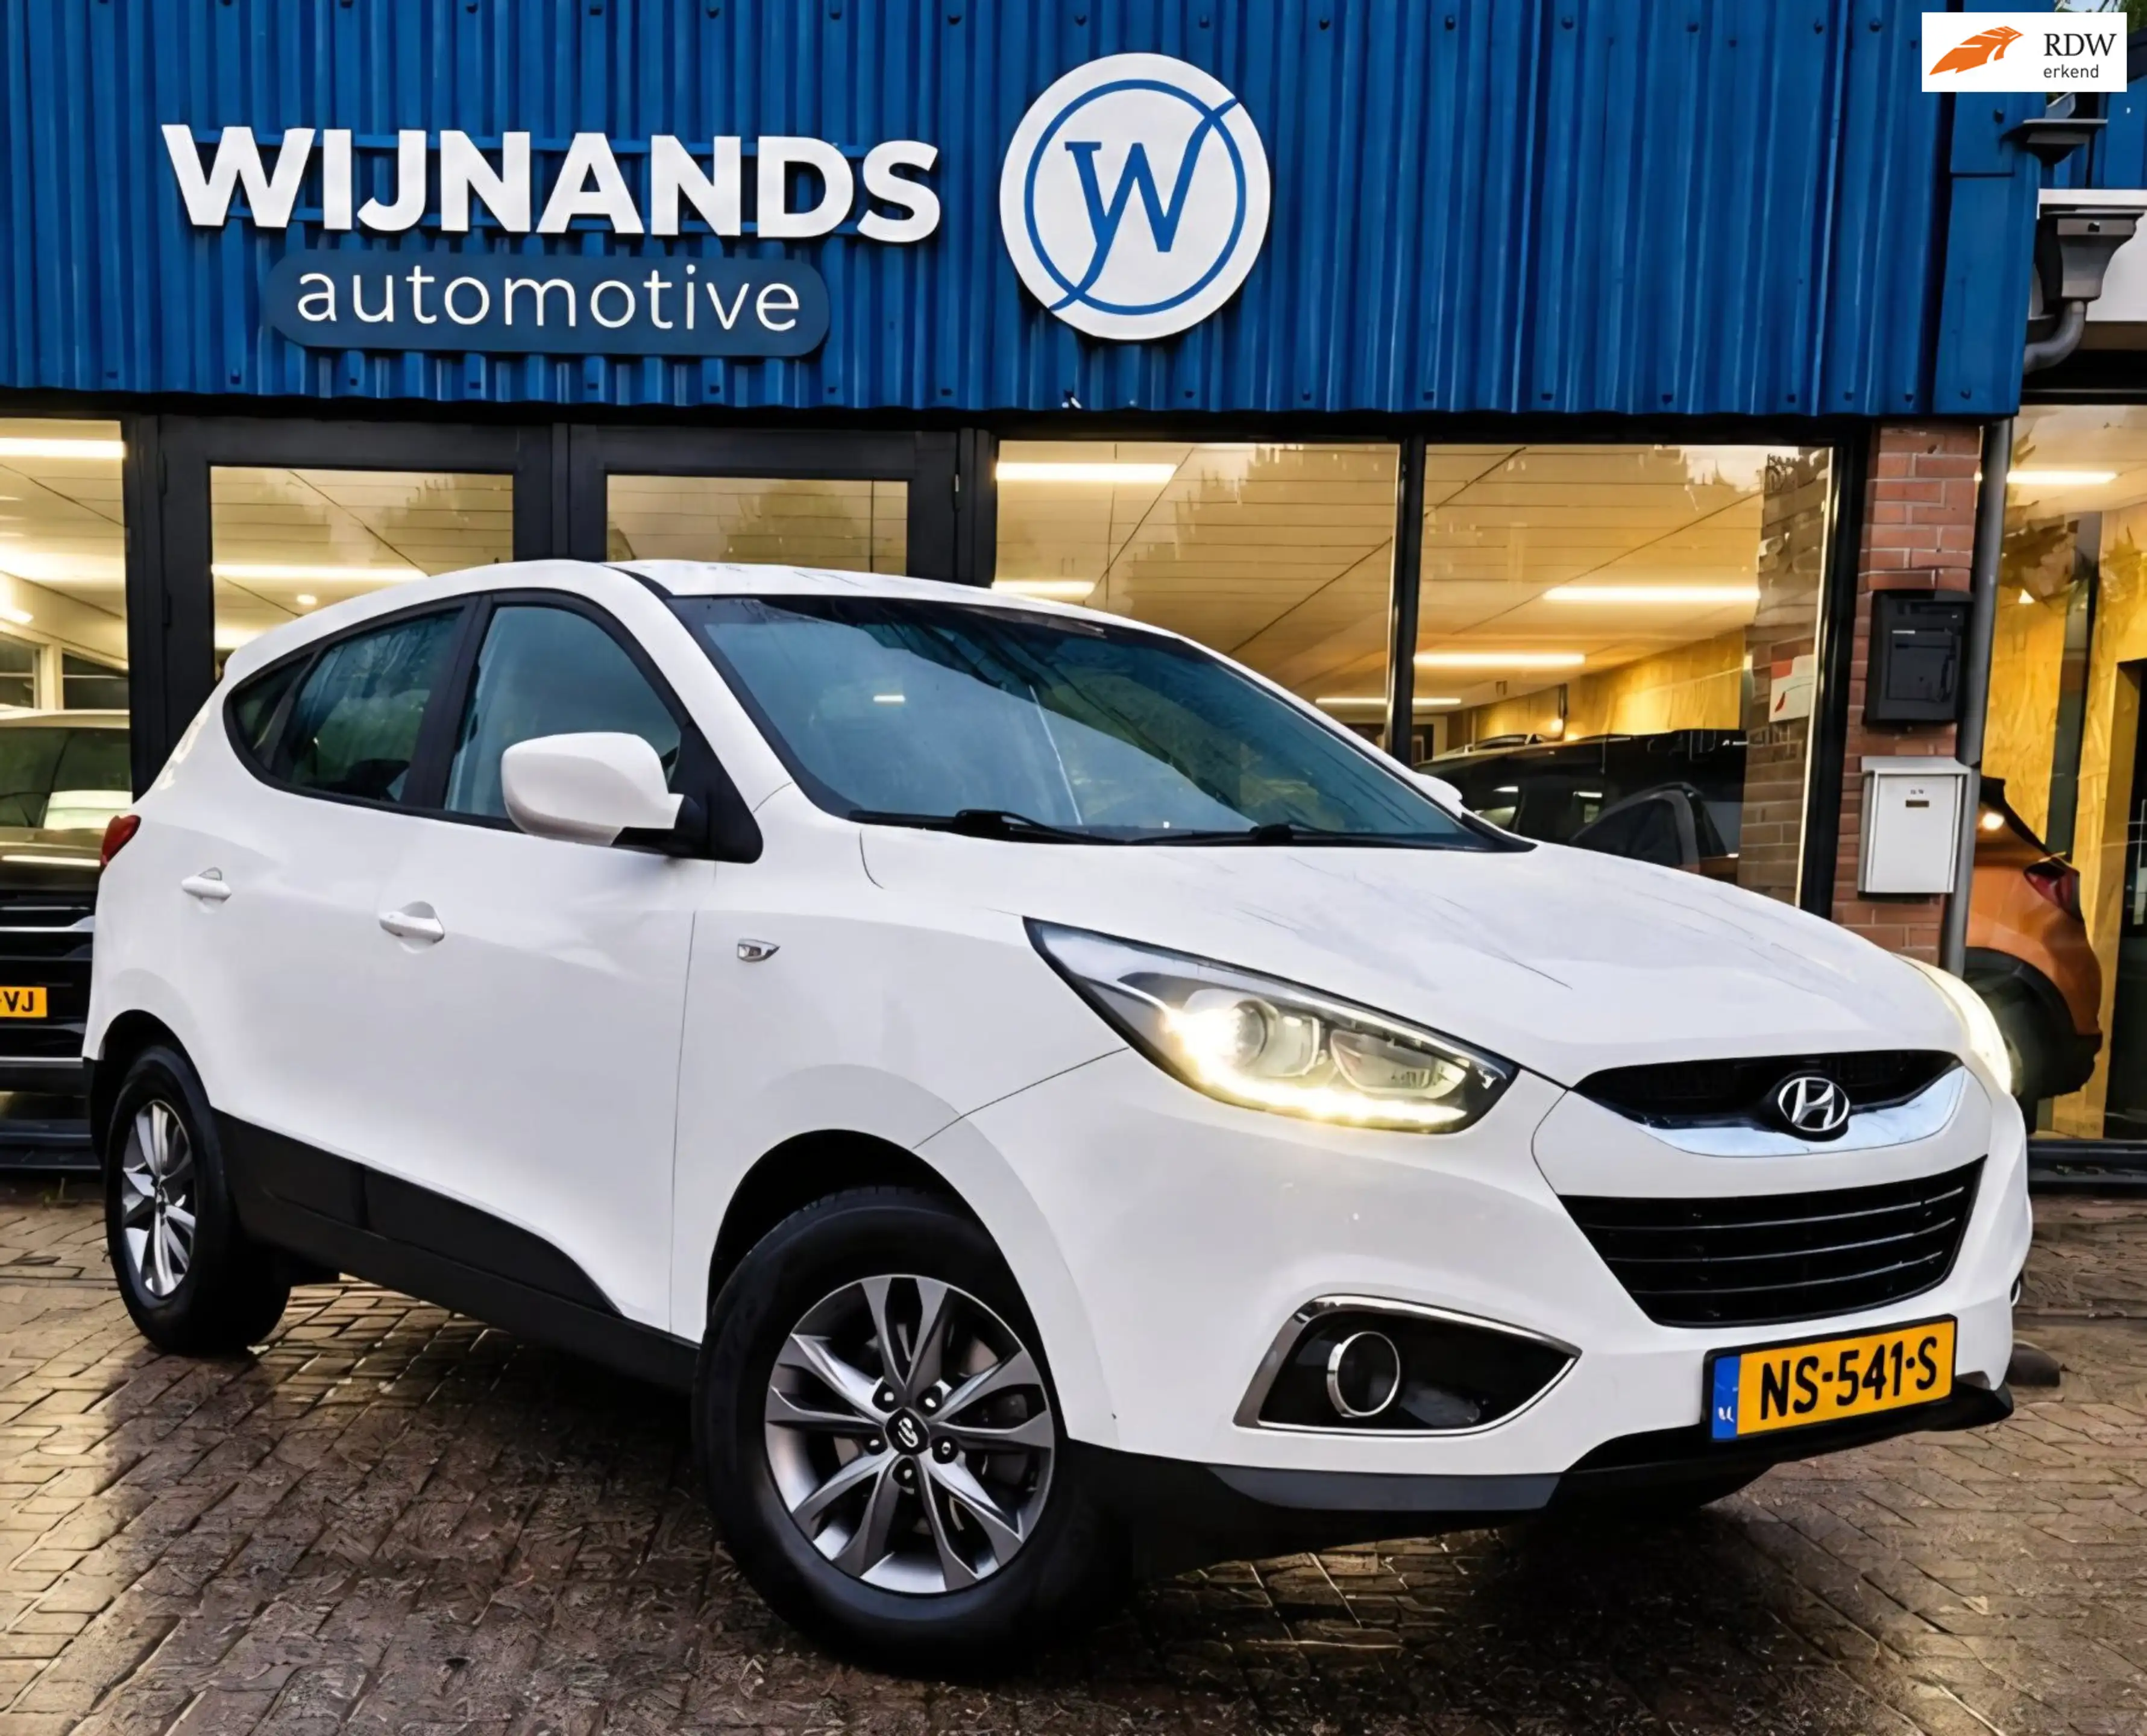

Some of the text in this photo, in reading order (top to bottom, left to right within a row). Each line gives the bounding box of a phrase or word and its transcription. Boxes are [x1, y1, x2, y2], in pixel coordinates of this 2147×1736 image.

[161, 124, 940, 242] WIJNANDS
[297, 264, 799, 331] automotive
[1759, 1336, 1937, 1420] NS-541-S
